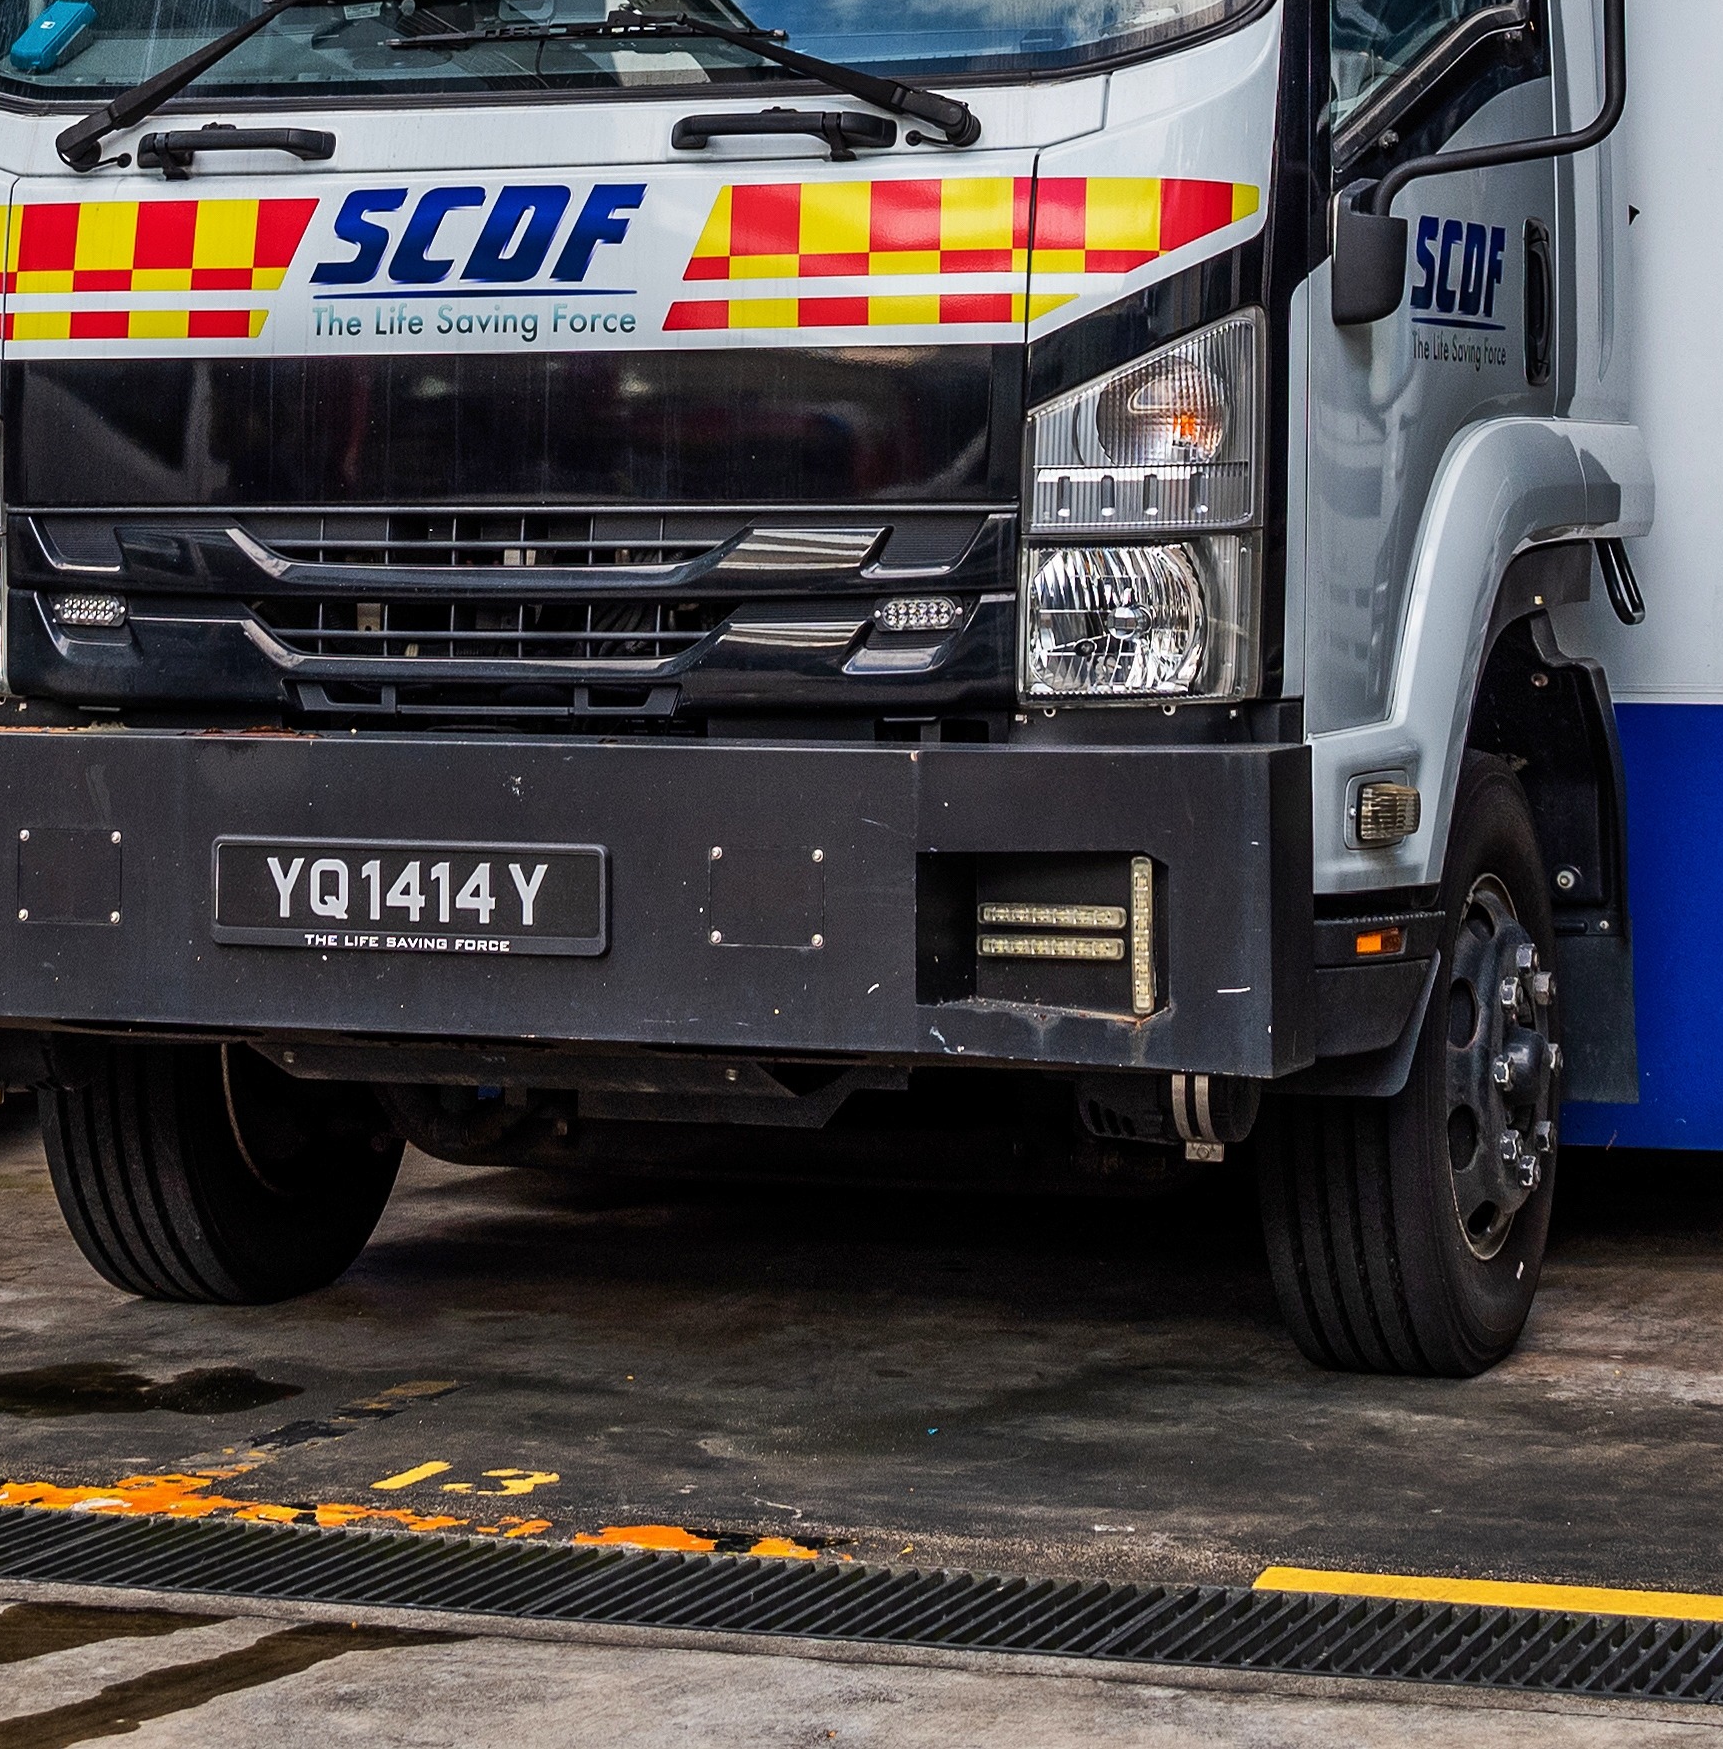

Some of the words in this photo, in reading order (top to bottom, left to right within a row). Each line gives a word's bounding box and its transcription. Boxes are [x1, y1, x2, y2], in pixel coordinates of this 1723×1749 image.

[308, 183, 648, 285] SCDF
[1410, 215, 1506, 318] SCDF
[312, 305, 362, 336] The
[375, 303, 424, 336] Life
[436, 303, 539, 343] Saving
[552, 303, 637, 334] Force
[1412, 331, 1430, 360] The
[1432, 334, 1449, 362] Life
[1451, 335, 1481, 372] Saving
[1483, 336, 1507, 366] Force
[304, 933, 338, 948] THE
[344, 934, 380, 949] LIFE
[386, 935, 448, 950] SAVING
[454, 938, 511, 952] FORCE
